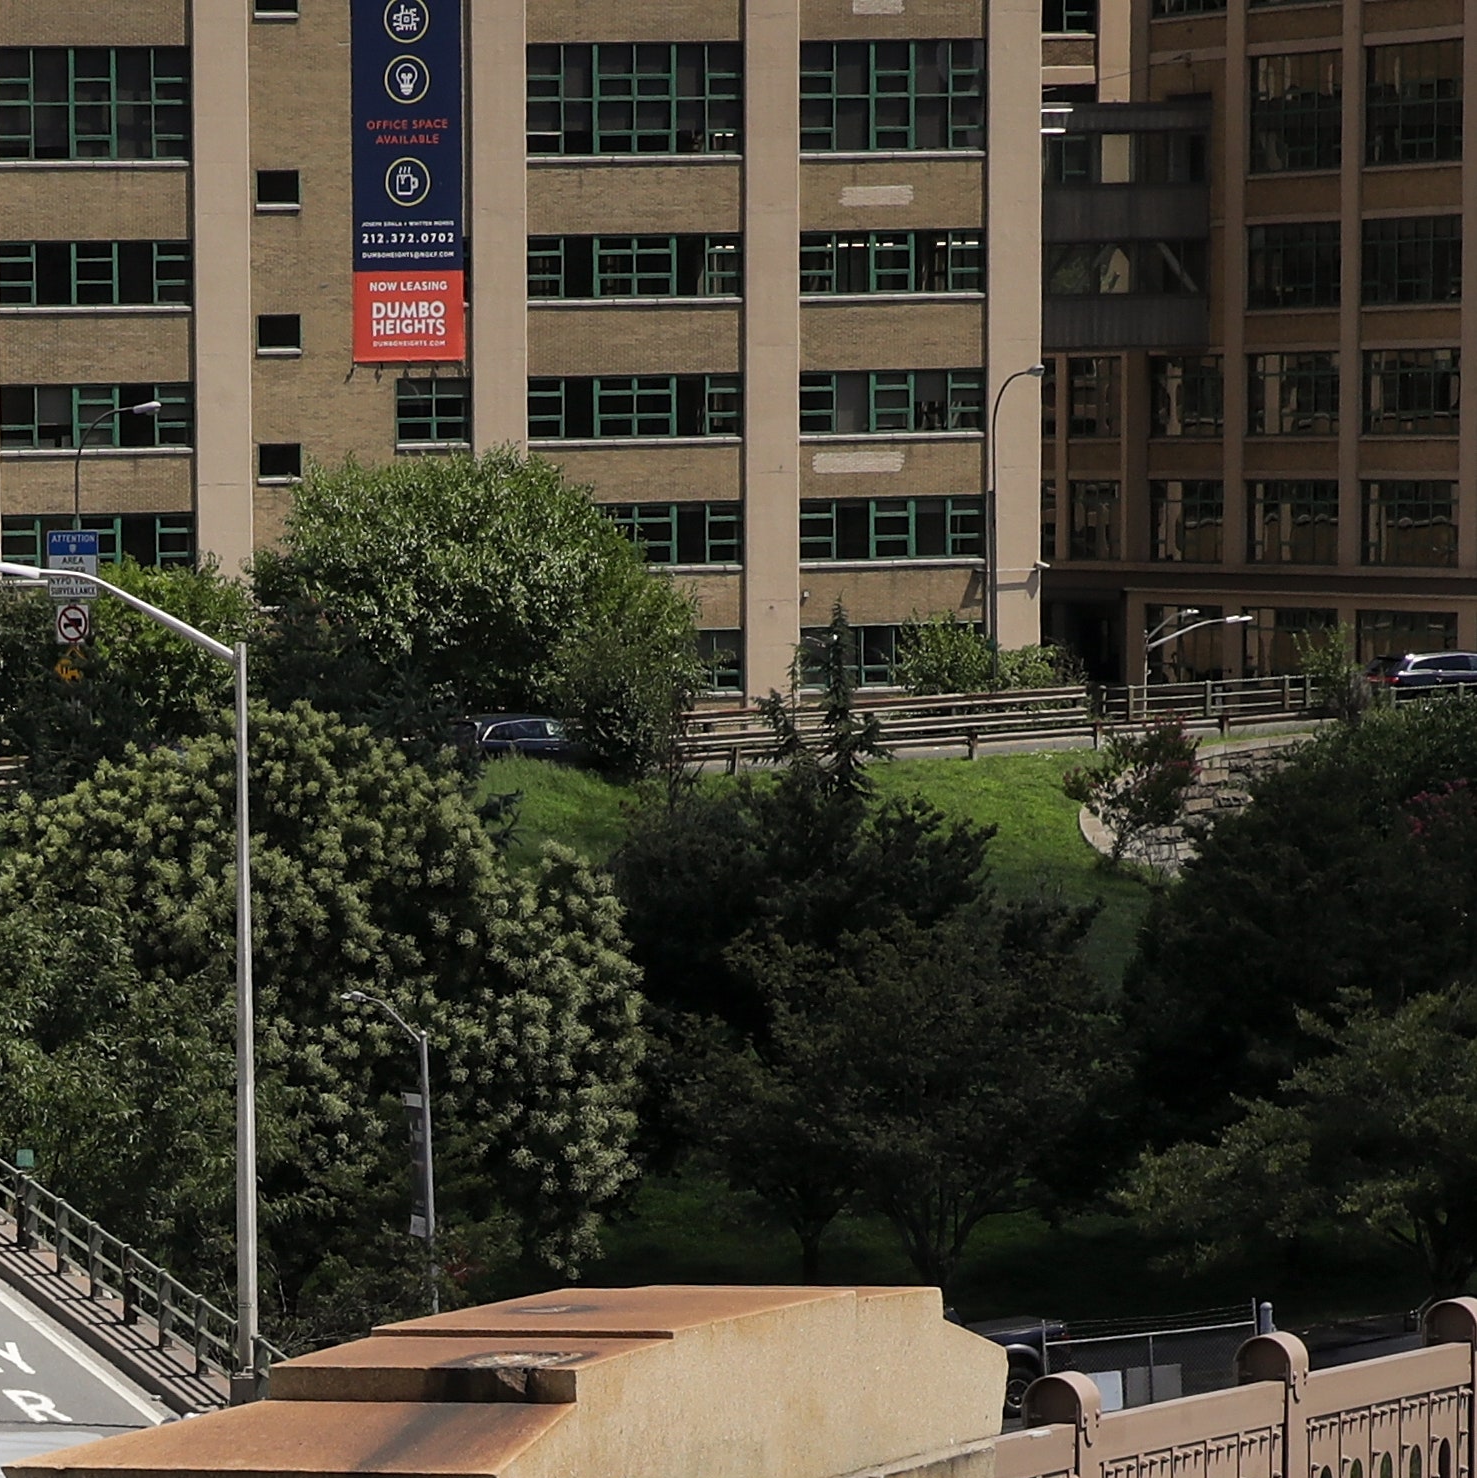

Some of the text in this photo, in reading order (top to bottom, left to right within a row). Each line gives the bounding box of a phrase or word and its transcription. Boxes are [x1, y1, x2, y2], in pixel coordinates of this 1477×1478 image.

[367, 118, 448, 130] OFFICE SPACE
[376, 134, 439, 144] AVAILABLE
[362, 233, 454, 244] 212.372.0702
[370, 281, 447, 291] NOW LEASING
[372, 301, 445, 318] DUMBO
[373, 320, 445, 336] HEIGHTS
